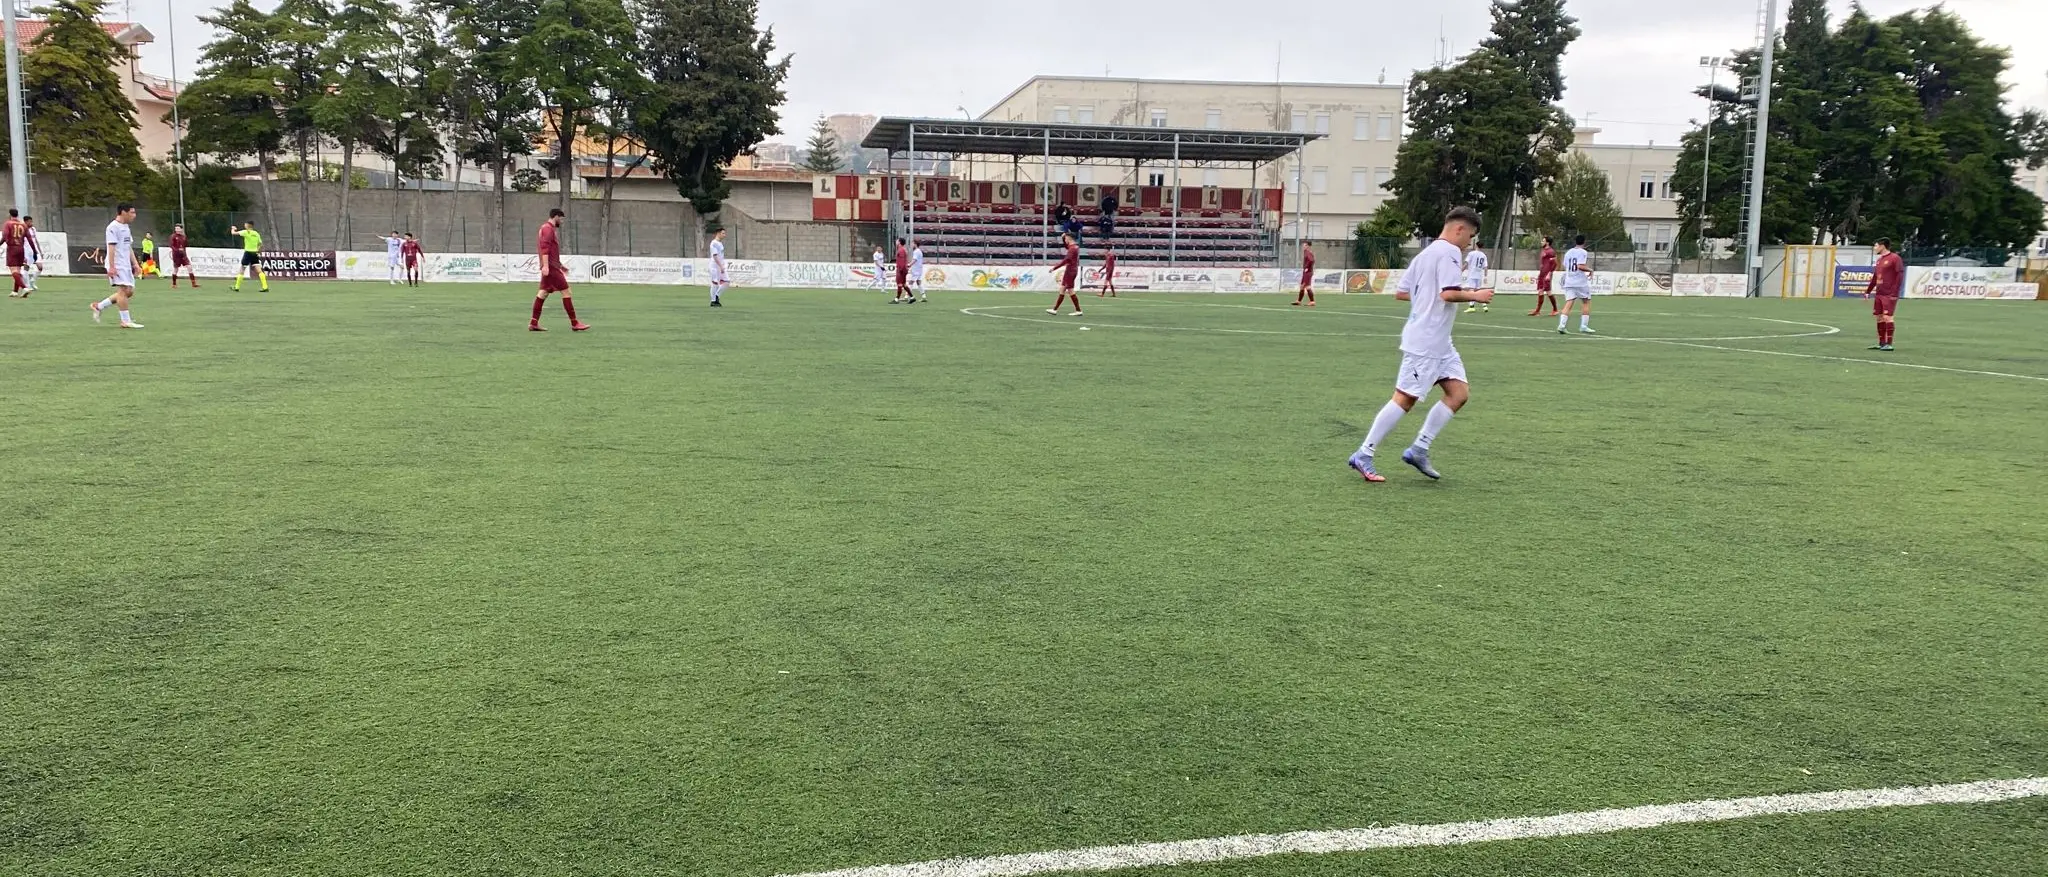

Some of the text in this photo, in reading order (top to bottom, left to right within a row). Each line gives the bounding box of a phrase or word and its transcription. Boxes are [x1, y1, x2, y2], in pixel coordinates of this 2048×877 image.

[13, 224, 24, 238] 10
[259, 259, 331, 270] ARBER SHOP
[789, 262, 845, 273] FARMACIA
[1475, 257, 1485, 268] 19
[1568, 257, 1578, 272] 18
[789, 271, 844, 281] SQUILLACE
[1158, 274, 1213, 282] IGEA
[1504, 276, 1524, 285] GOLD
